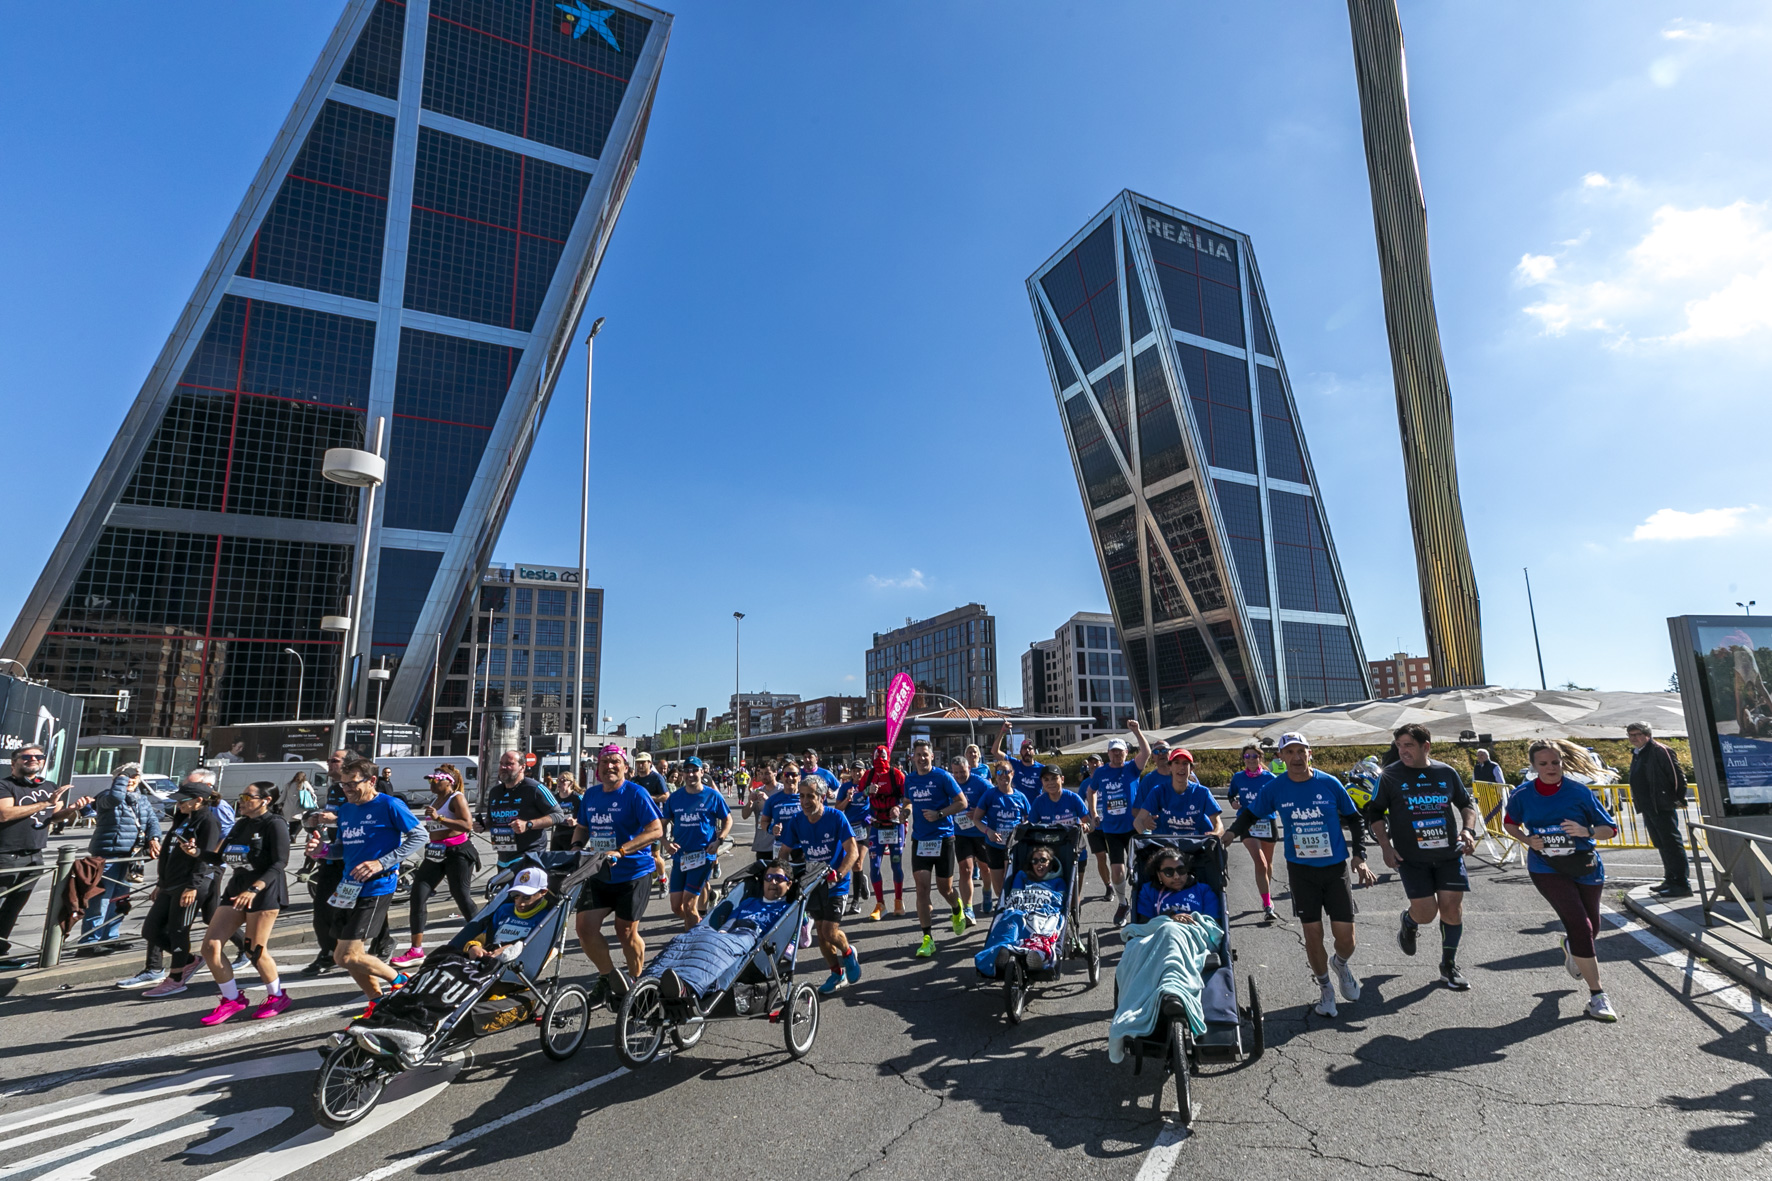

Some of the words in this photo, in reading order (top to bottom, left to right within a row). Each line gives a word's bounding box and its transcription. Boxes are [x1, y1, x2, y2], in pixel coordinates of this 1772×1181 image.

[1146, 216, 1232, 262] REALIA
[520, 568, 558, 581] testa
[1408, 795, 1449, 805] MADRID
[1420, 803, 1441, 811] CIELO
[491, 810, 519, 818] MADRID
[1421, 828, 1444, 837] 39016
[1301, 836, 1321, 845] 8135
[1541, 835, 1566, 844] 38699
[510, 918, 529, 926] ZURICH
[500, 928, 521, 937] ADRIÁN
